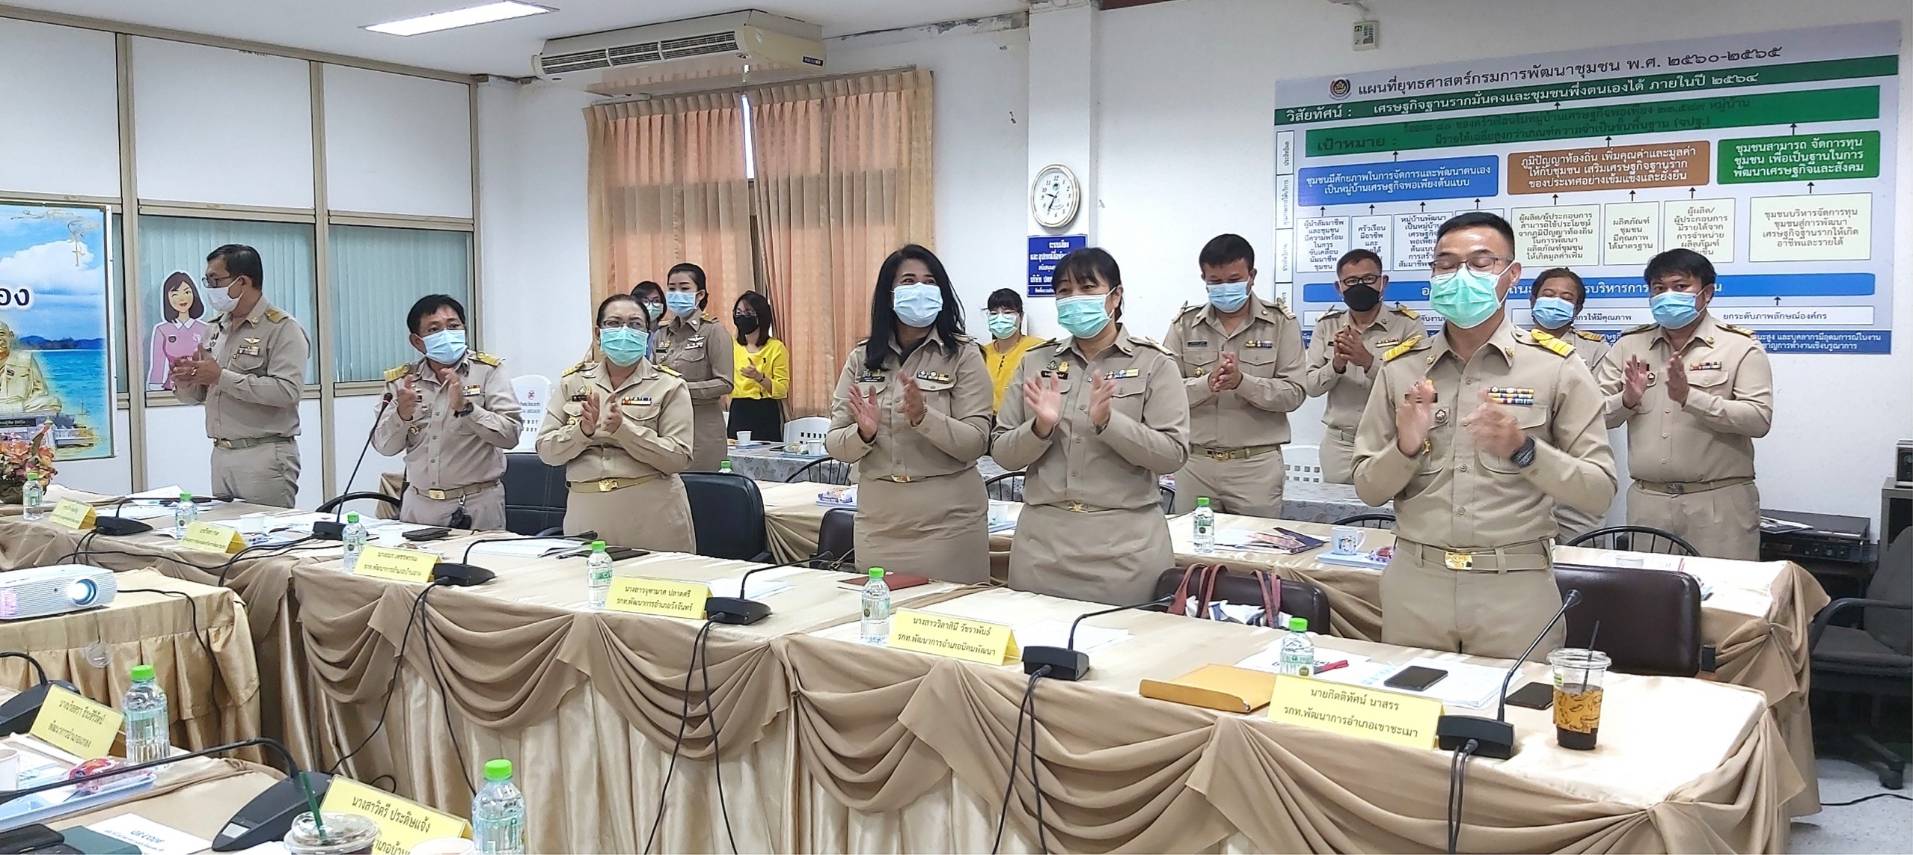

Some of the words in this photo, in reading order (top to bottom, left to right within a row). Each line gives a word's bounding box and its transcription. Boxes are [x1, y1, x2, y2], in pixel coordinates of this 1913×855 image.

[1358, 61, 1620, 96] แผนที่ยุทธศาสตร์กรมการพัฒนาชุมชน
[1626, 57, 1661, 71] พ.ศ.
[1374, 79, 1644, 114] เศรษฐกิจฐานรากมั่นคงและชุมชนพึ่งตนเองได้
[1649, 74, 1706, 90] ภายในปี
[1286, 104, 1343, 122] วิสัยทัศน์
[1317, 135, 1386, 151] เป้าหมาย
[1735, 141, 1807, 154] ชุมชนสามารถ
[1810, 137, 1863, 150] จัดการทุน
[1521, 152, 1598, 171] ภูมิปัญญาท้องถิ่น
[1734, 154, 1765, 167] ชุมชน
[1769, 149, 1864, 165] เพื่อเป็นฐานในการ
[1306, 166, 1491, 189] ชุมชนมีศักยภาพในการจัดการและพัฒนาตนเอง
[1529, 163, 1581, 178] ให้กับชุมชน
[1584, 159, 1688, 176] เสริมเศรษฐกิจฐานราก
[1733, 161, 1864, 178] พัฒนาเศรษฐกิจและสังคม
[1324, 178, 1470, 197] เป็นหมู่บ้านเศรษฐกิจพอเพียงต้นแบบ
[1764, 207, 1858, 220] ชุมชนบริหารจัดการทุน
[1777, 237, 1844, 247] อาชีพและรายได้
[0, 288, 30, 306] อง
[1310, 688, 1367, 705] นายกิตติทัศน์
[1370, 698, 1400, 711] นาสรร
[1284, 705, 1418, 737] รกท.พัฒนาการอำเภอเขาชะเมา
[351, 796, 391, 818] นางสาวิตรี
